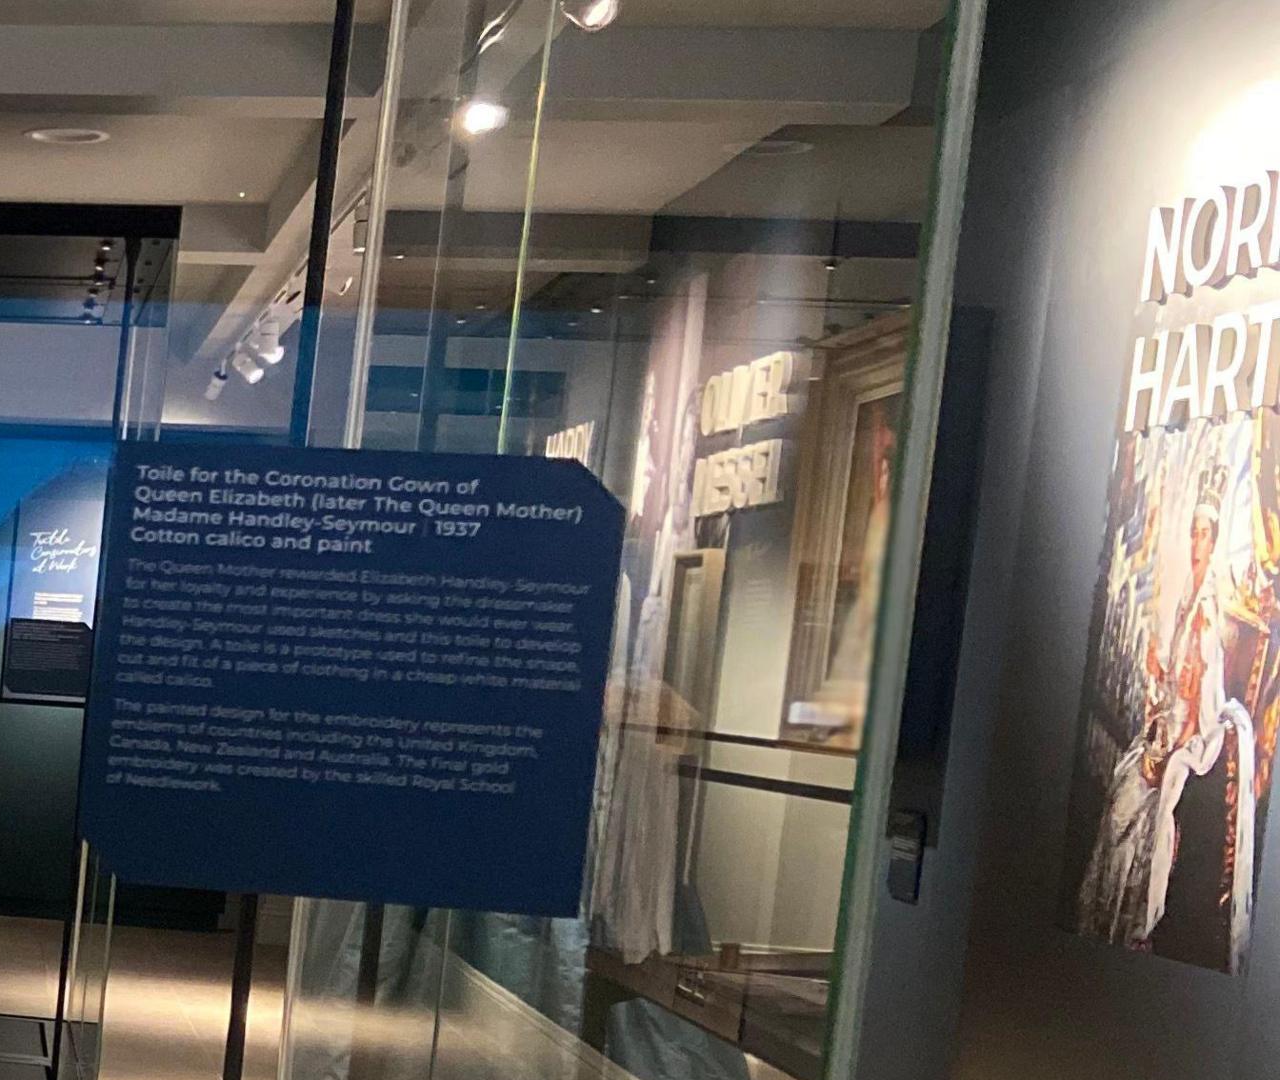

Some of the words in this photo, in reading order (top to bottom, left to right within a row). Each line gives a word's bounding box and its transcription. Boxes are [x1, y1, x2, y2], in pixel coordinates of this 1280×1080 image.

[1141, 169, 1280, 302] NOR
[136, 464, 186, 483] Toile
[189, 466, 219, 483] for
[223, 468, 260, 485] the
[264, 469, 383, 491] Coronation
[387, 475, 450, 494] Gown
[456, 478, 480, 495] of
[134, 485, 203, 504] Queen
[208, 488, 306, 508] Elizabeth
[310, 492, 367, 512] (later
[373, 495, 413, 513] The
[417, 498, 490, 517] Queen
[496, 501, 583, 525] Mother)
[132, 506, 223, 525] Madame
[228, 510, 417, 536] Handley-Seymour
[434, 519, 482, 537] 1937
[129, 525, 200, 545] Cotton
[204, 530, 266, 548] calico
[270, 534, 312, 550] and
[316, 535, 373, 554] paint
